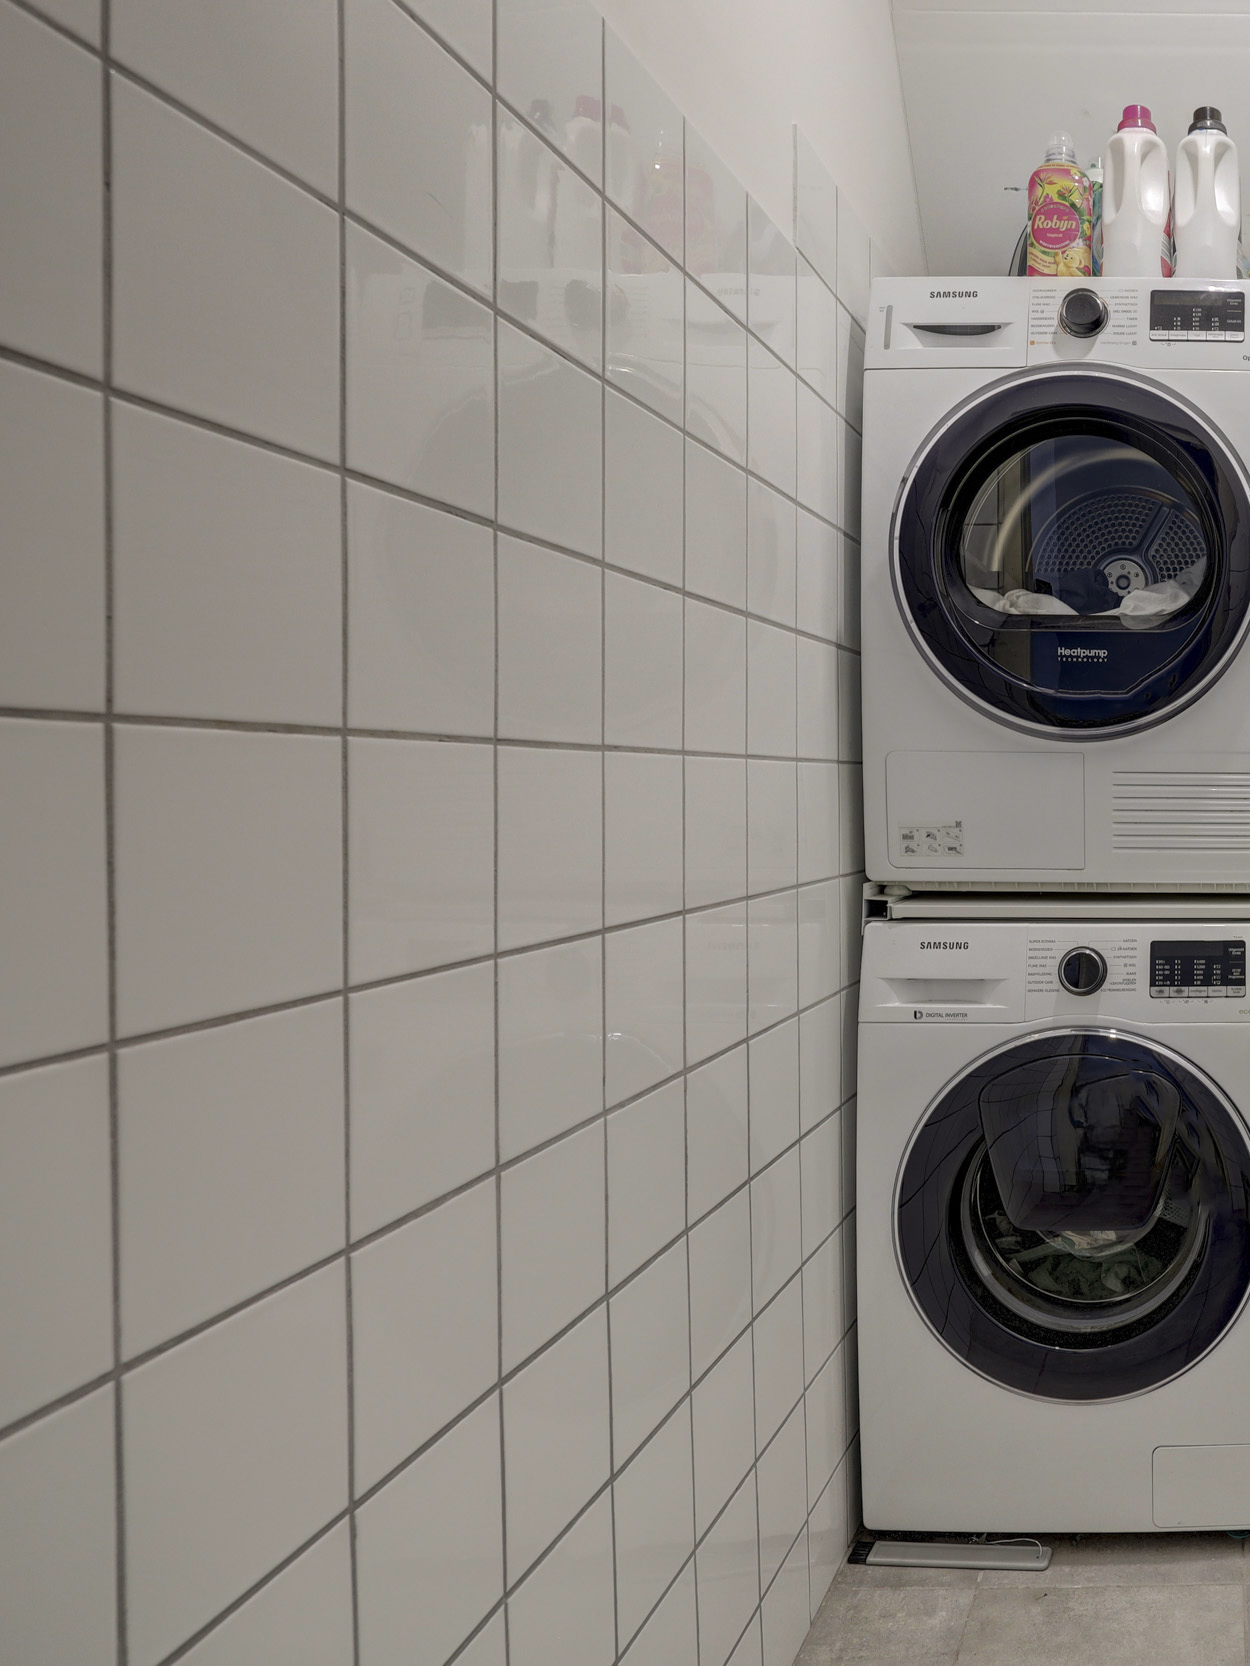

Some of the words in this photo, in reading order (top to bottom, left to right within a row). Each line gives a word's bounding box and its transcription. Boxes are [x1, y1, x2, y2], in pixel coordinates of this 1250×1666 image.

[1035, 215, 1076, 231] Robijn
[929, 290, 978, 299] SAMSUNG
[1057, 647, 1108, 658] Heatpump
[919, 941, 970, 950] SAMSUNG
